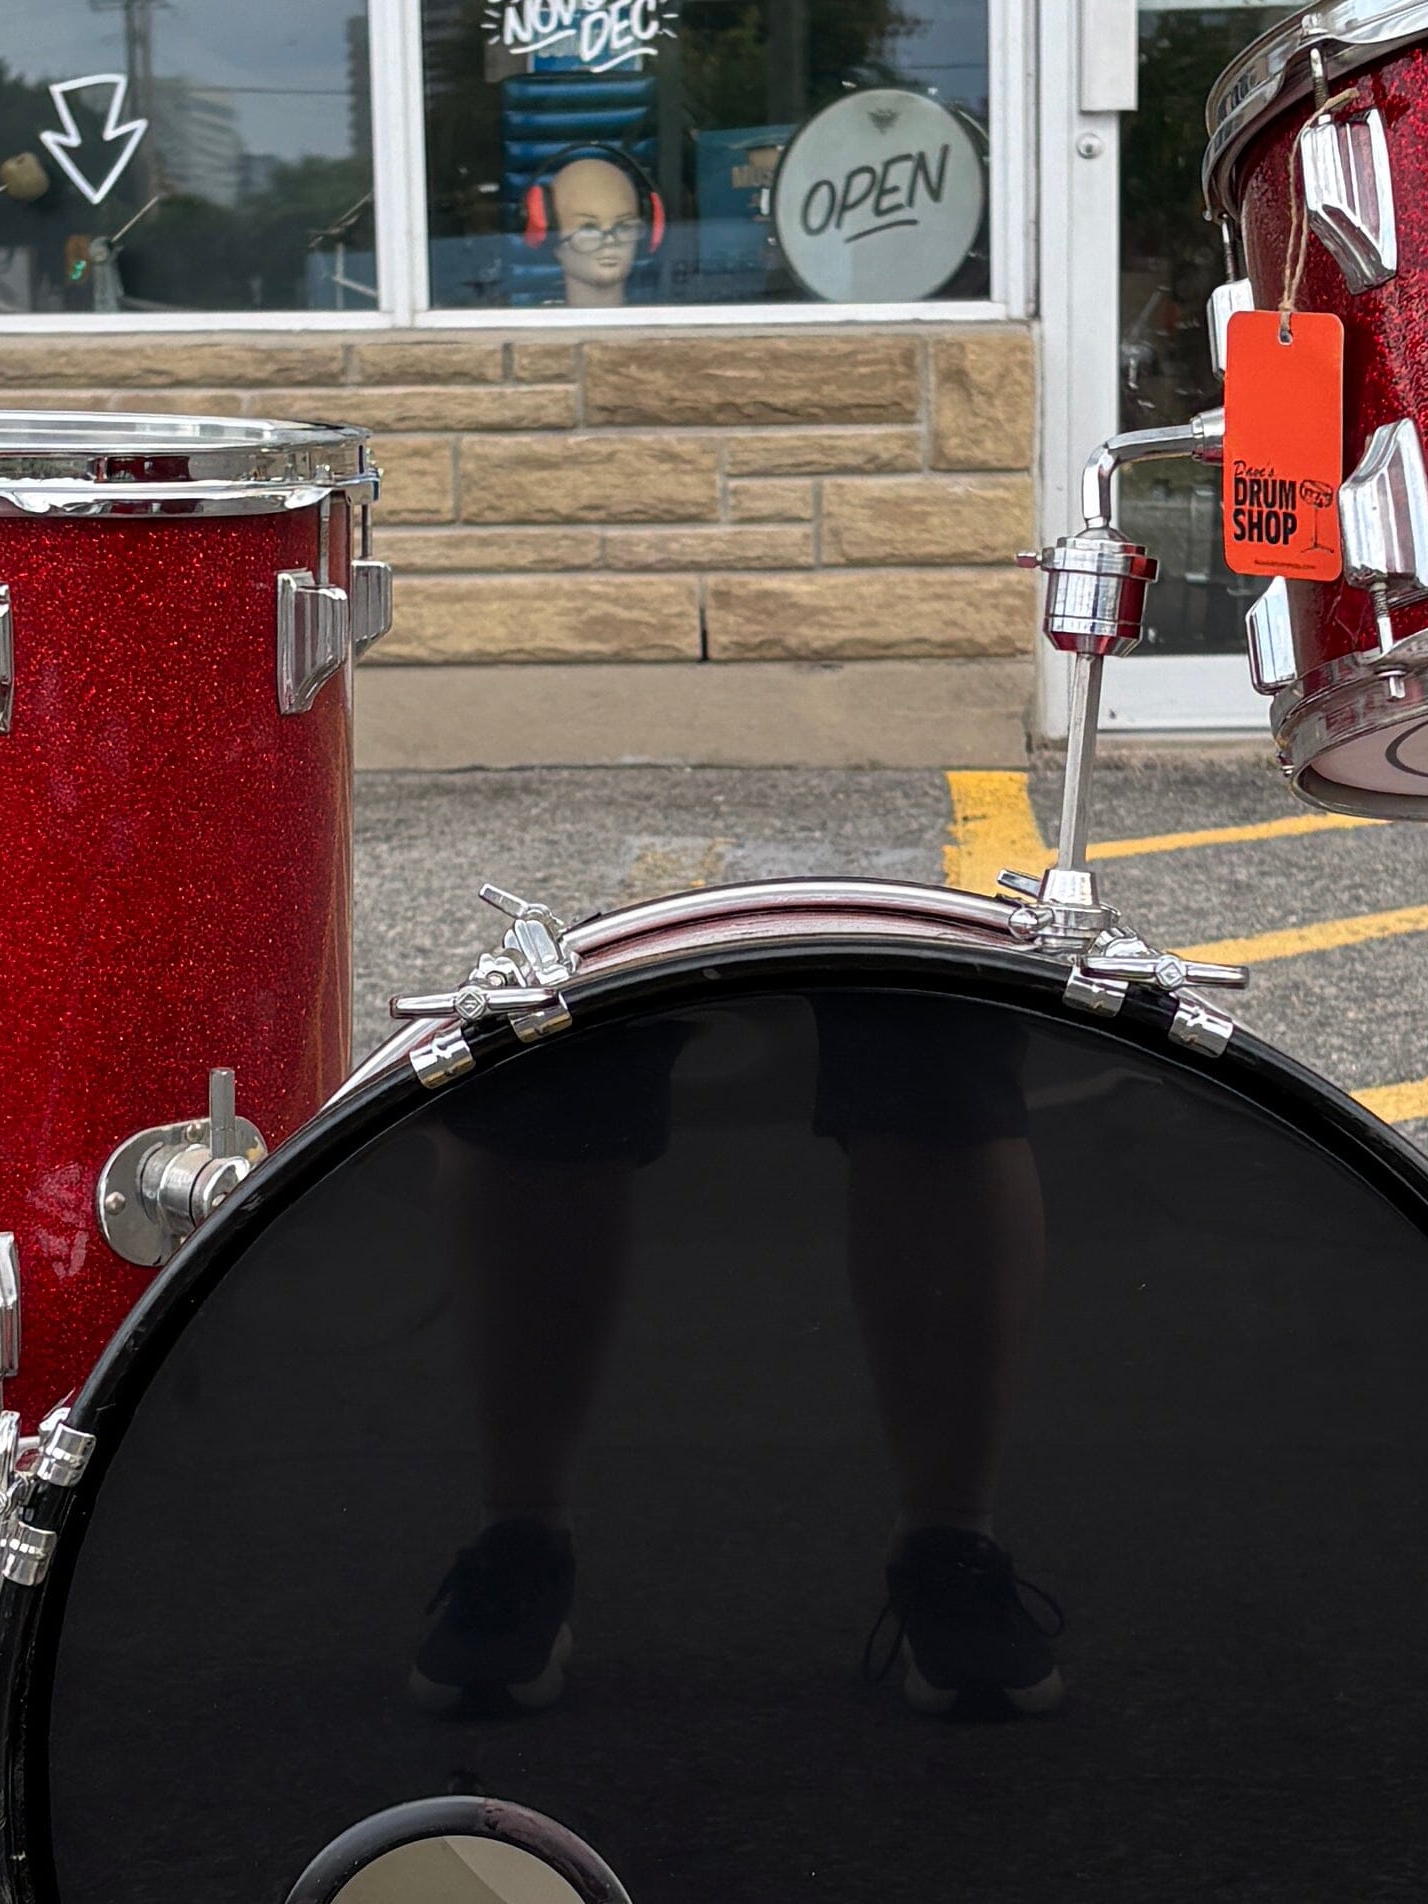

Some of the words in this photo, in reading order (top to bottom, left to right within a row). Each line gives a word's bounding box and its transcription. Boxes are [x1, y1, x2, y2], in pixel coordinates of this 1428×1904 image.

[800, 144, 950, 237] OPEN
[1233, 459, 1275, 478] Dave's
[1233, 477, 1297, 511] DRUM
[1232, 507, 1298, 546] SHOP
